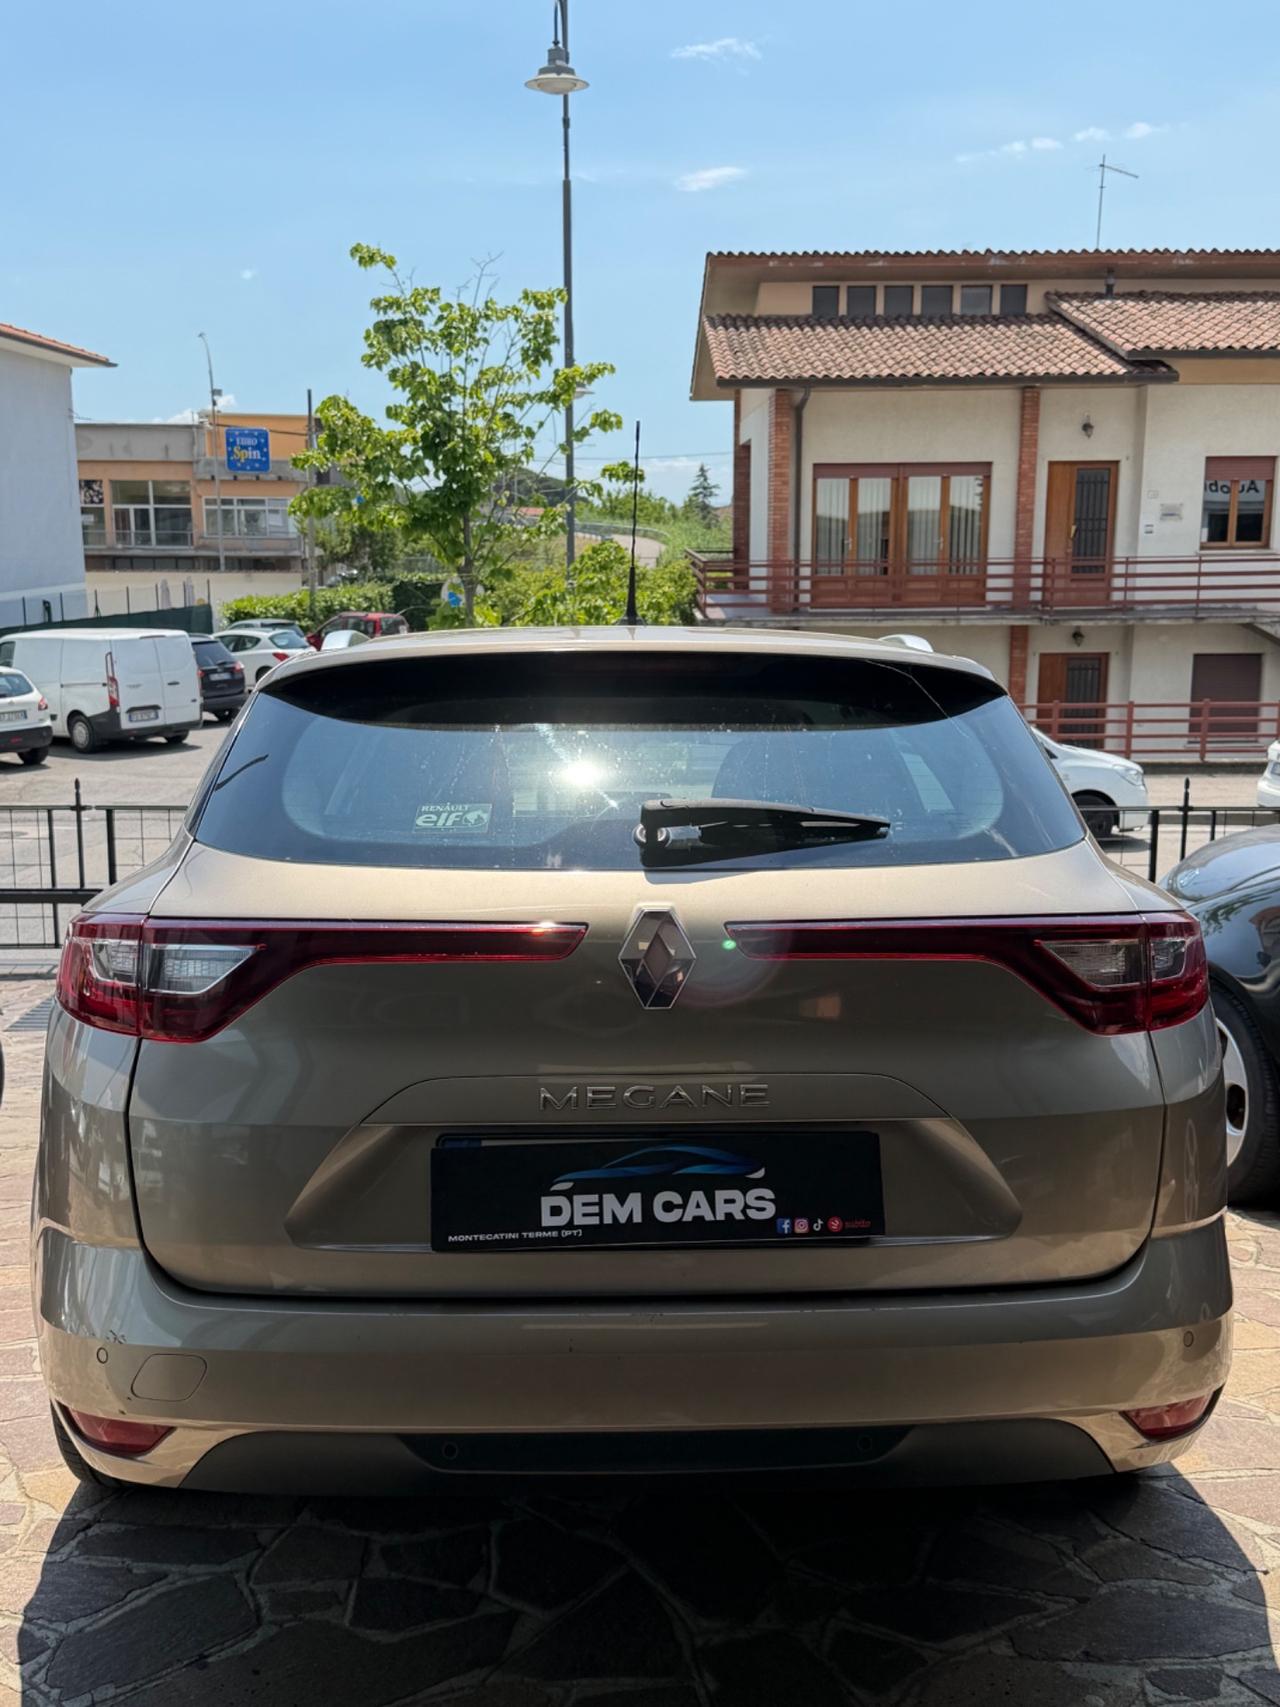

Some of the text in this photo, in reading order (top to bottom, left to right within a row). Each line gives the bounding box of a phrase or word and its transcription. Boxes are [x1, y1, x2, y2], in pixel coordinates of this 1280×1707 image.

[233, 446, 262, 463] Spin
[421, 803, 469, 812] RENAULT
[415, 812, 463, 827] elf
[539, 1083, 771, 1111] MEGANE
[541, 1187, 777, 1228] DEM CARS
[447, 1228, 583, 1243] MONTECATINI TERME (PT)
